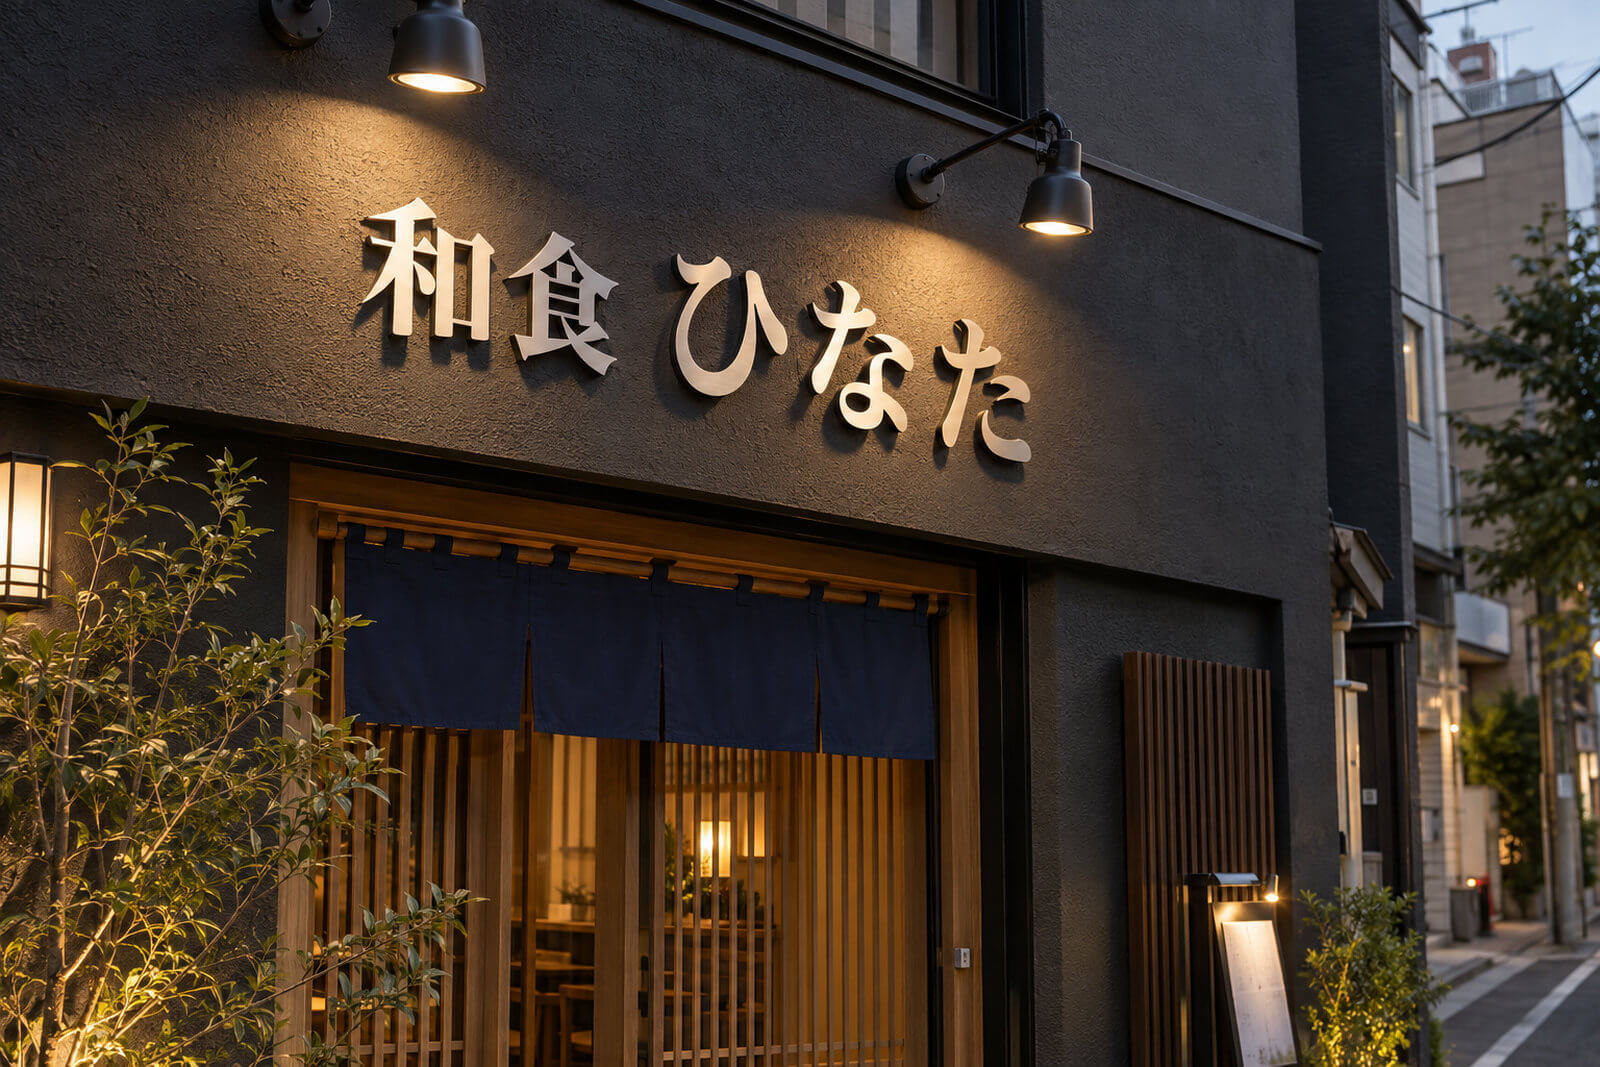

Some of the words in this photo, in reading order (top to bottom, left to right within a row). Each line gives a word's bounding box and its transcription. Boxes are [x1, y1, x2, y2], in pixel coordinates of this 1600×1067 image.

[361, 197, 618, 376] 和食
[672, 253, 1031, 463] ひなた
